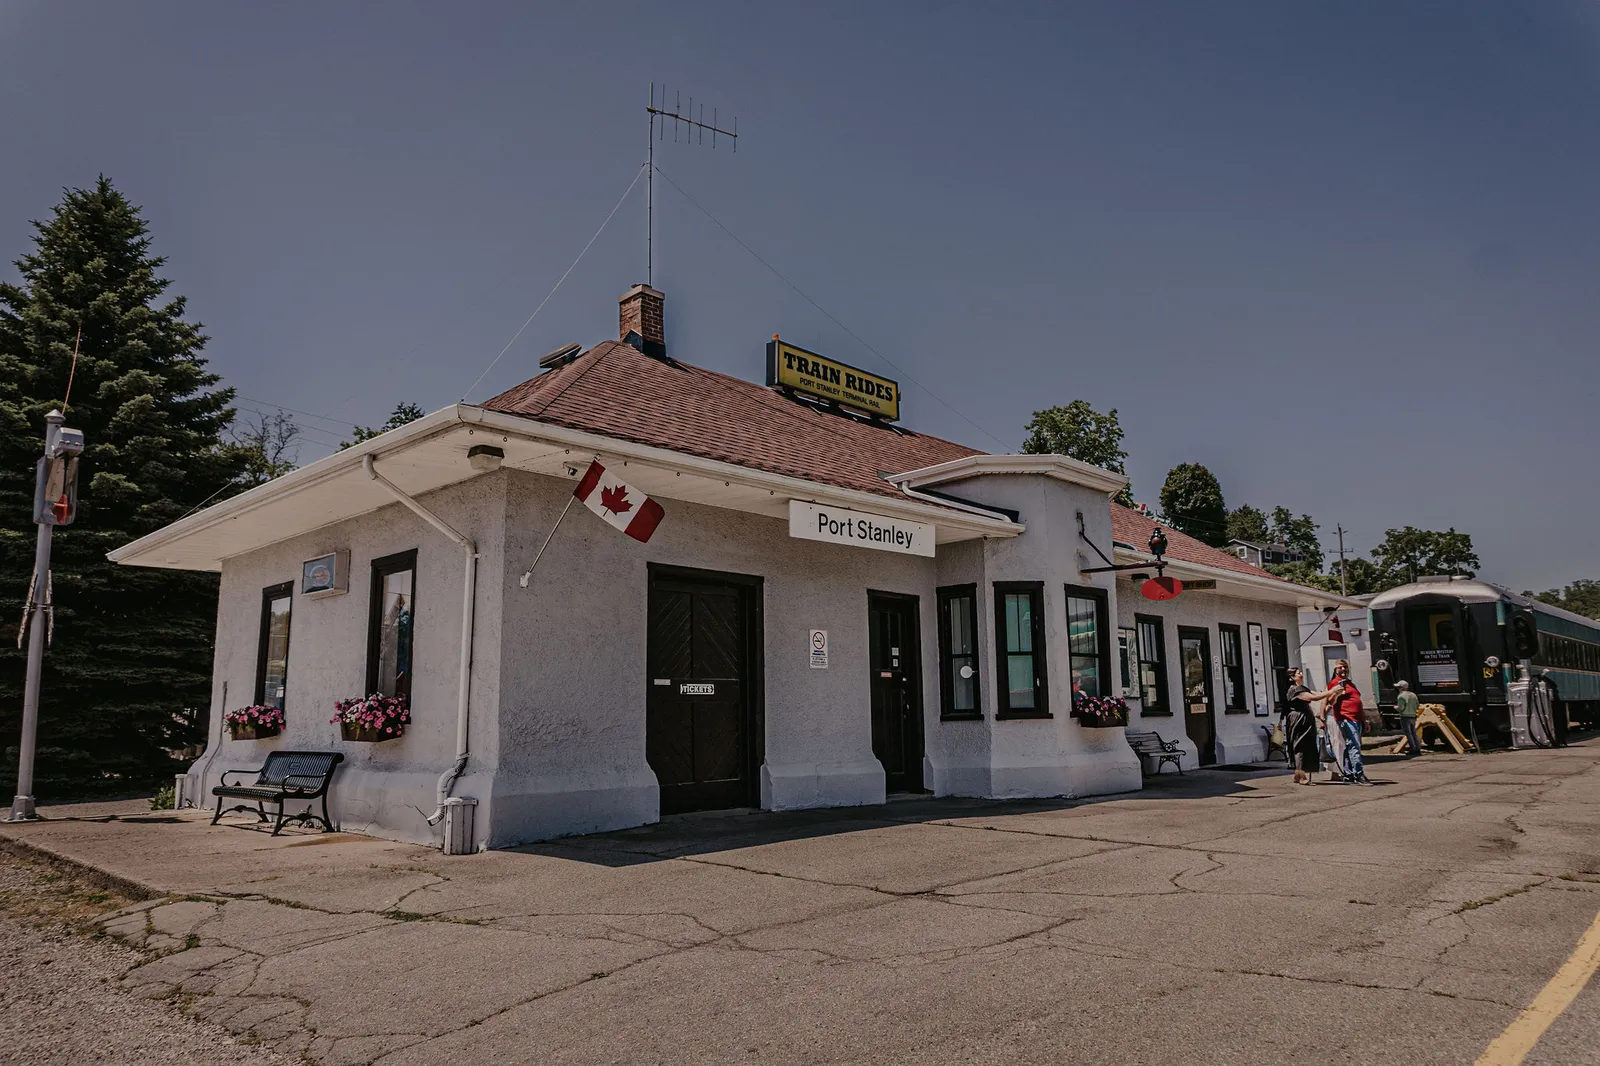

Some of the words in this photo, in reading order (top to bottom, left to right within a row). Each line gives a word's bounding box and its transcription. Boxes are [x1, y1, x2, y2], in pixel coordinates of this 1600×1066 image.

[784, 351, 841, 385] TRAIN
[845, 371, 893, 402] RIDES
[800, 377, 815, 387] PORT
[816, 383, 840, 396] STANLEY
[842, 391, 868, 406] TERMINAL
[868, 399, 880, 409] RAIL
[818, 513, 853, 538] Port
[857, 520, 913, 549] Stanley
[682, 685, 712, 693] TICKETS
